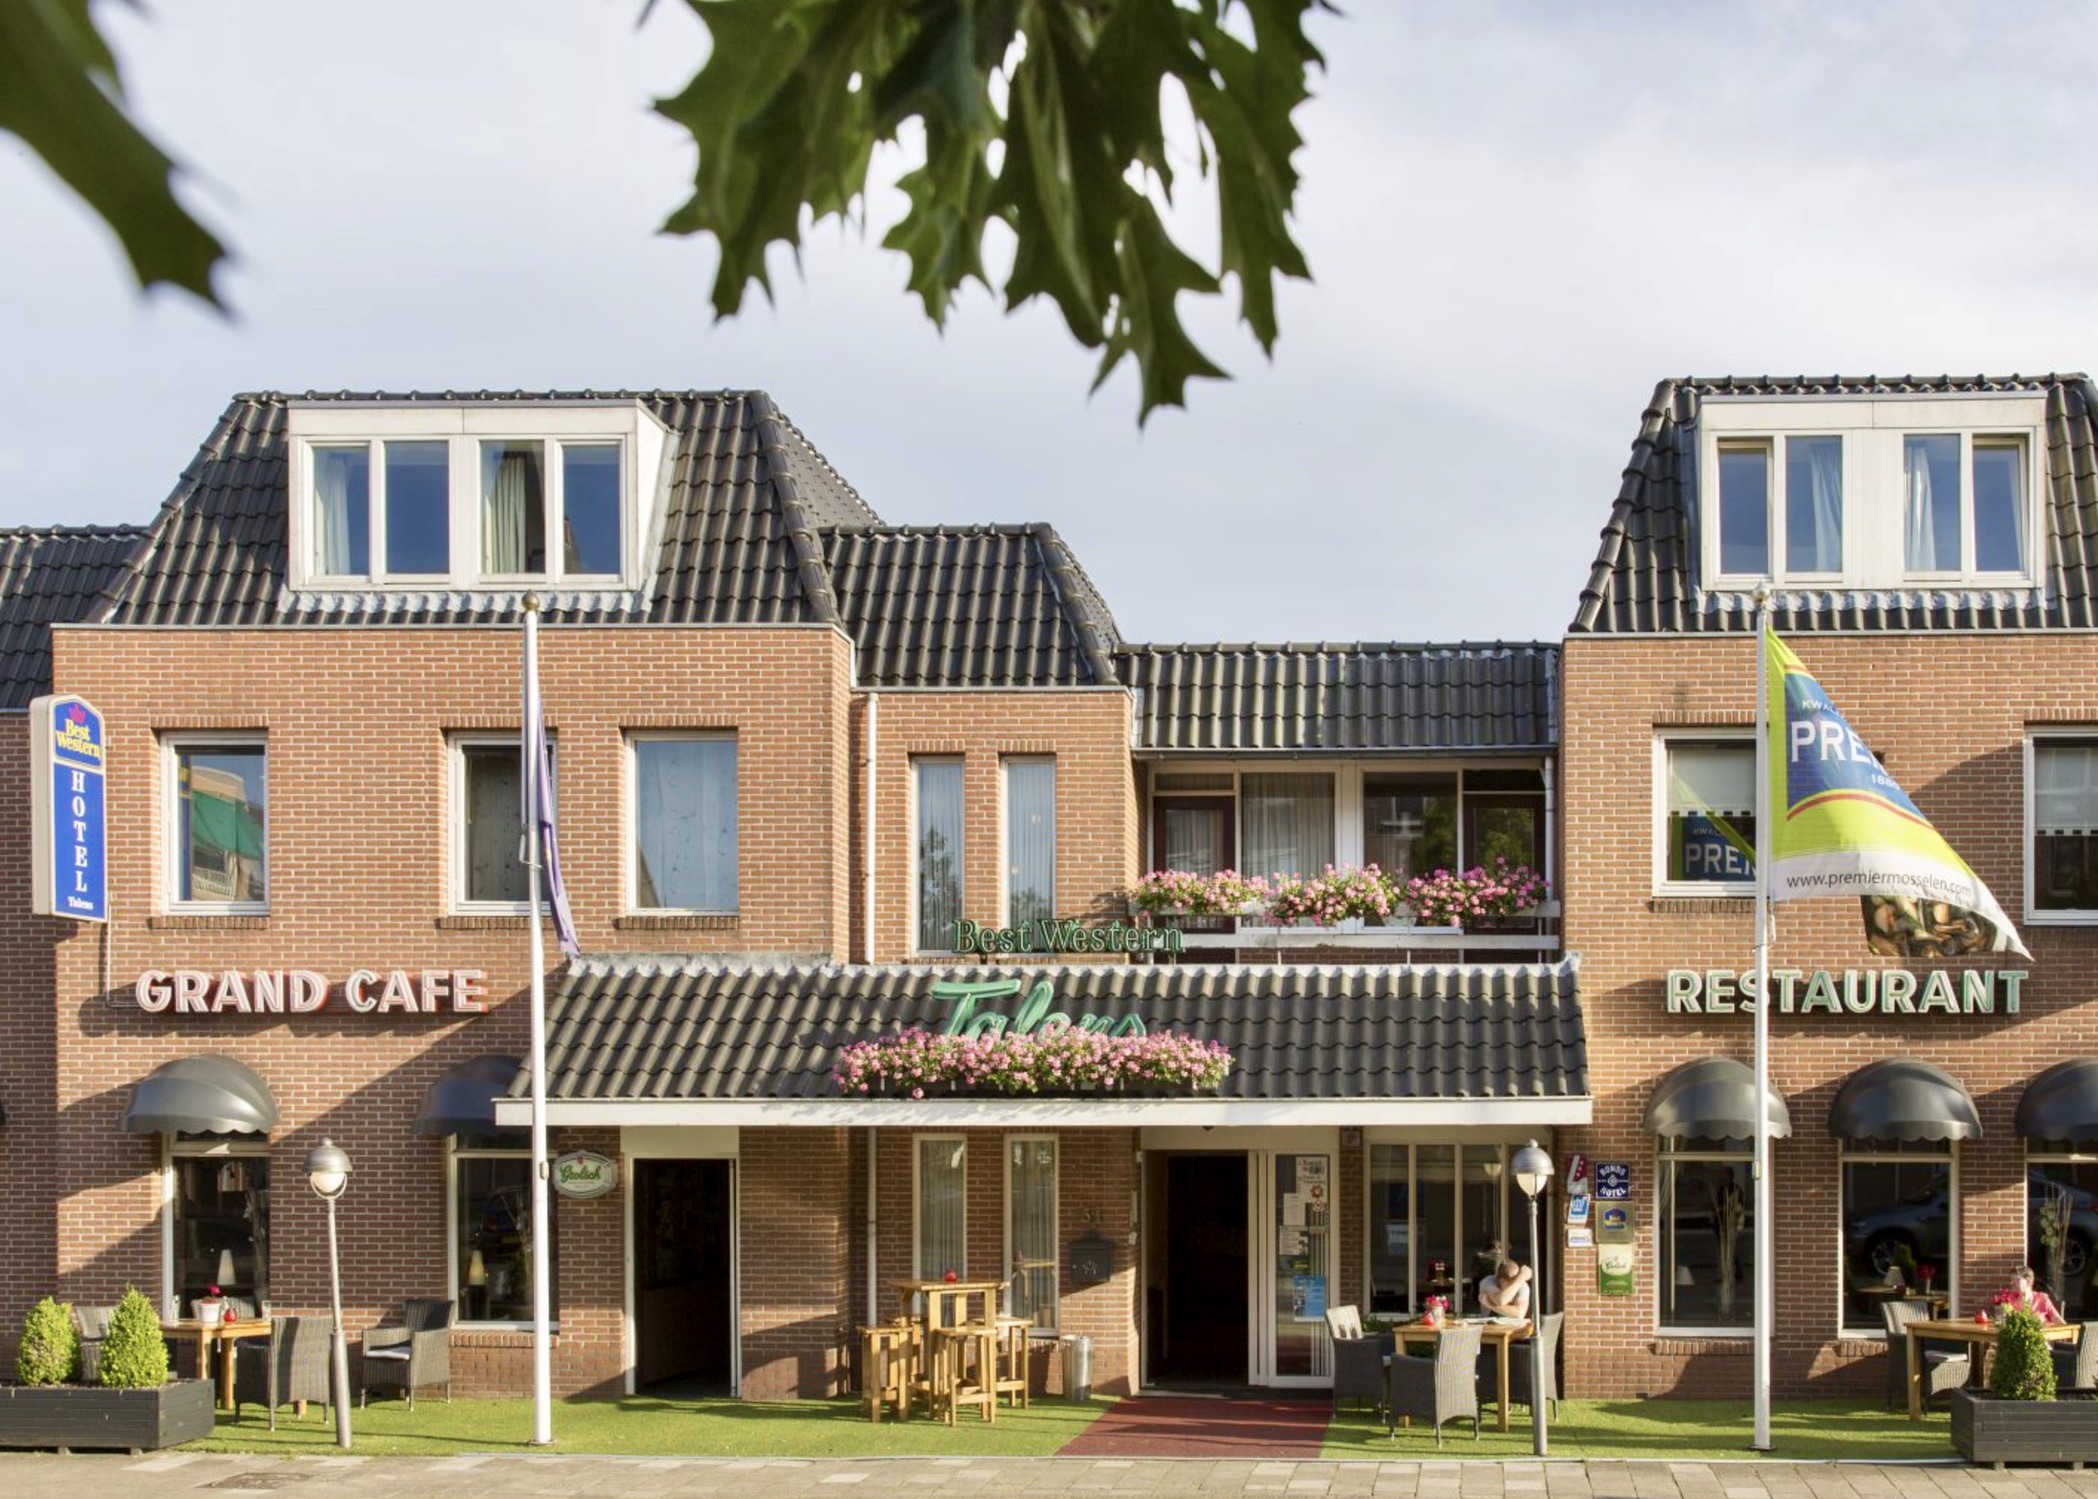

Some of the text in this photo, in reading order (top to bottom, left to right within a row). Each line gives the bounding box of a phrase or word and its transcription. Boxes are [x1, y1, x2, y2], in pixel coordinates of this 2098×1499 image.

[65, 718, 90, 741] Best
[55, 731, 100, 757] Western
[71, 770, 88, 893] HOTEL
[1786, 870, 1971, 896] www.premiermosselen.com
[952, 917, 1186, 953] Best Western
[134, 969, 489, 1014] GRAND CAFE
[1666, 969, 2029, 1014] RESTAURANT
[559, 1164, 602, 1184] Grolsch
[1599, 1185, 1628, 1198] HOTEL
